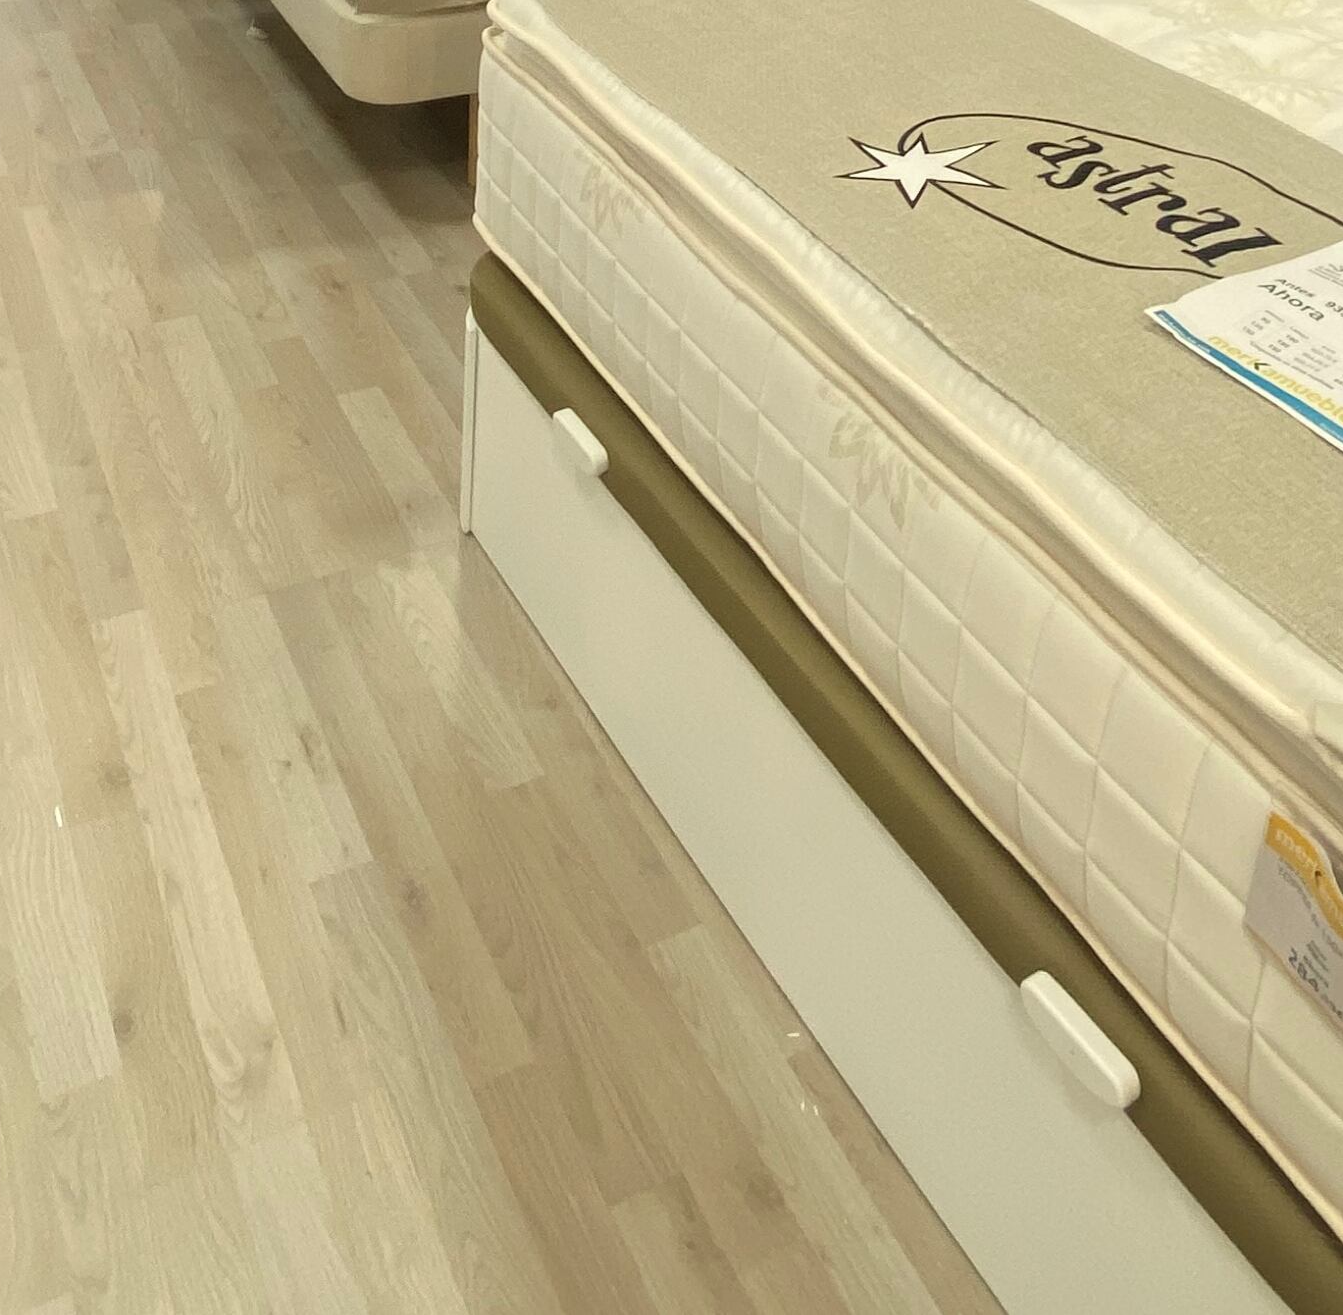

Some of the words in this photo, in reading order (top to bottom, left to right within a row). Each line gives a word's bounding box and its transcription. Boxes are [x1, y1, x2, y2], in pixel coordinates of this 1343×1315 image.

[1027, 136, 1284, 267] astral
[1257, 284, 1324, 321] Ahora
[1275, 278, 1315, 298] Antes
